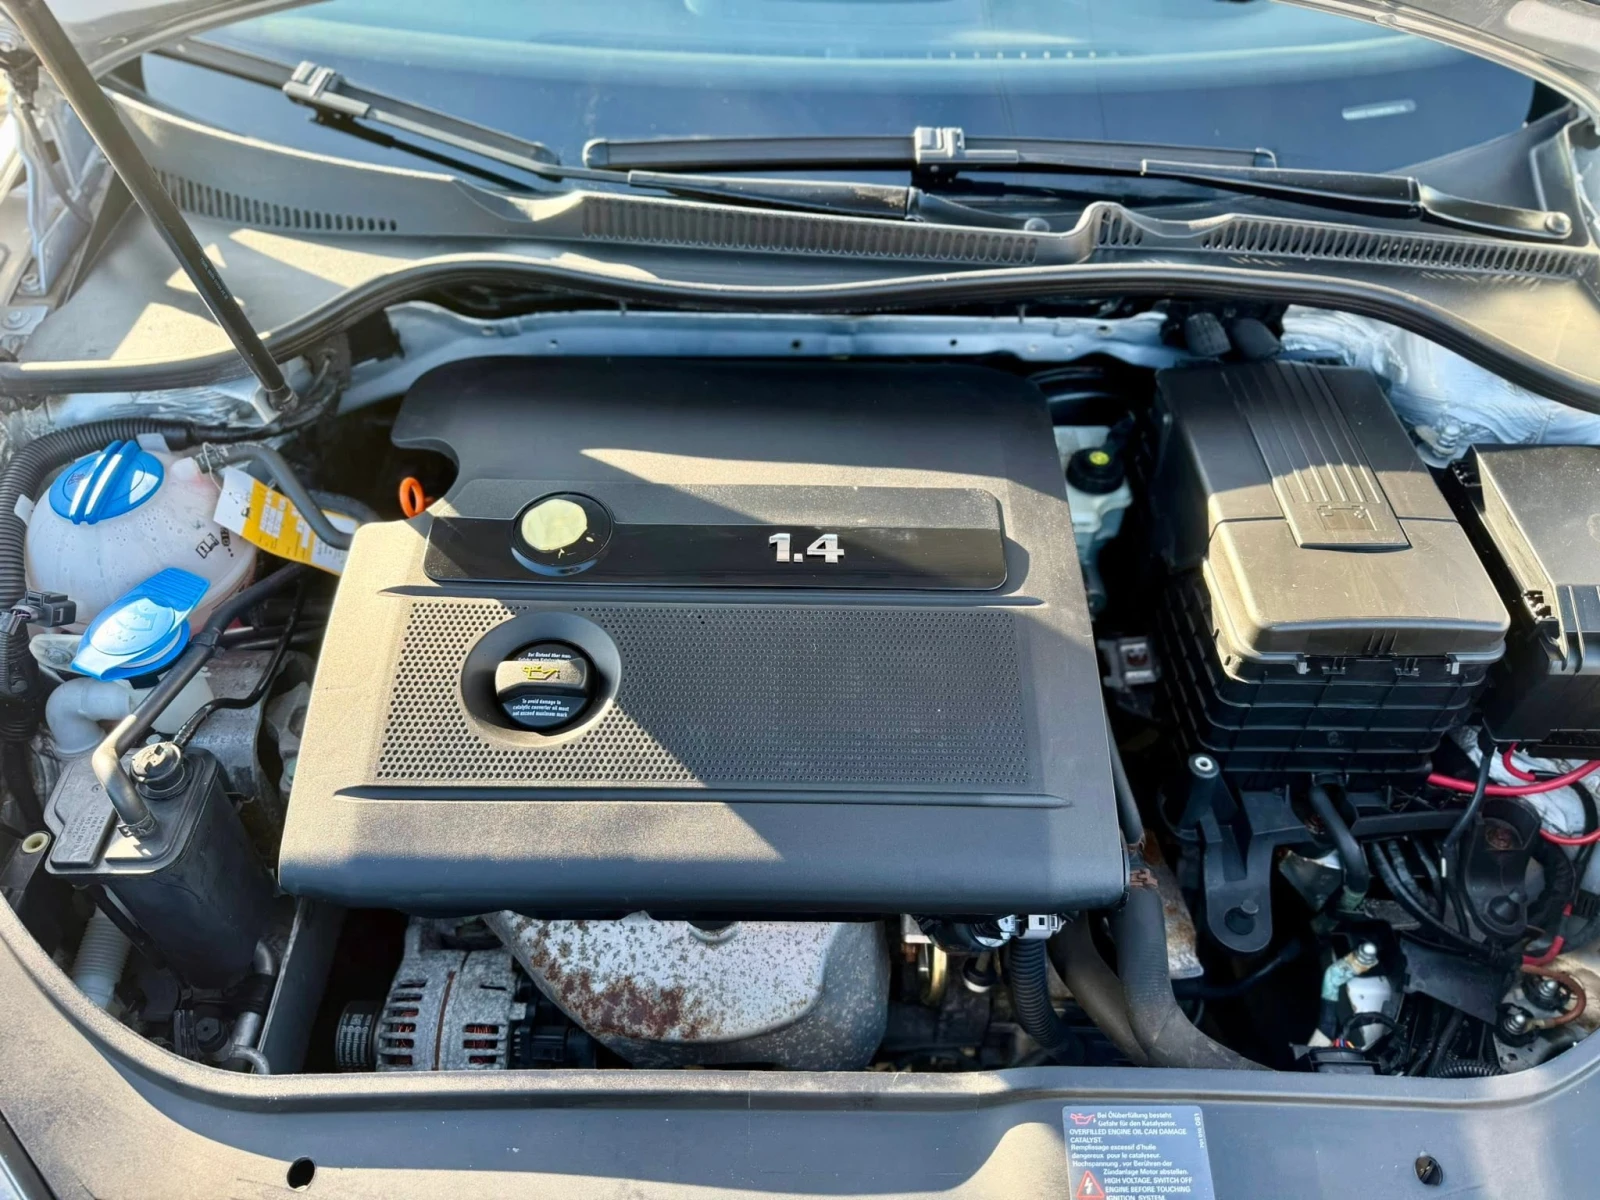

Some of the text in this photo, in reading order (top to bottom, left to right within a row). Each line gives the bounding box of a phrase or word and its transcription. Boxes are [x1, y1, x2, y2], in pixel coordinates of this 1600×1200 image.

[768, 533, 845, 563] 1.4
[1108, 1111, 1148, 1119] Ölüberfüllung
[1142, 1120, 1177, 1128] Katalysator.
[1071, 1152, 1104, 1160] dangereux
[1128, 1152, 1162, 1160] catalyseur.
[1103, 1168, 1139, 1176] Zündanlage
[1156, 1185, 1191, 1193] TOUCHING
